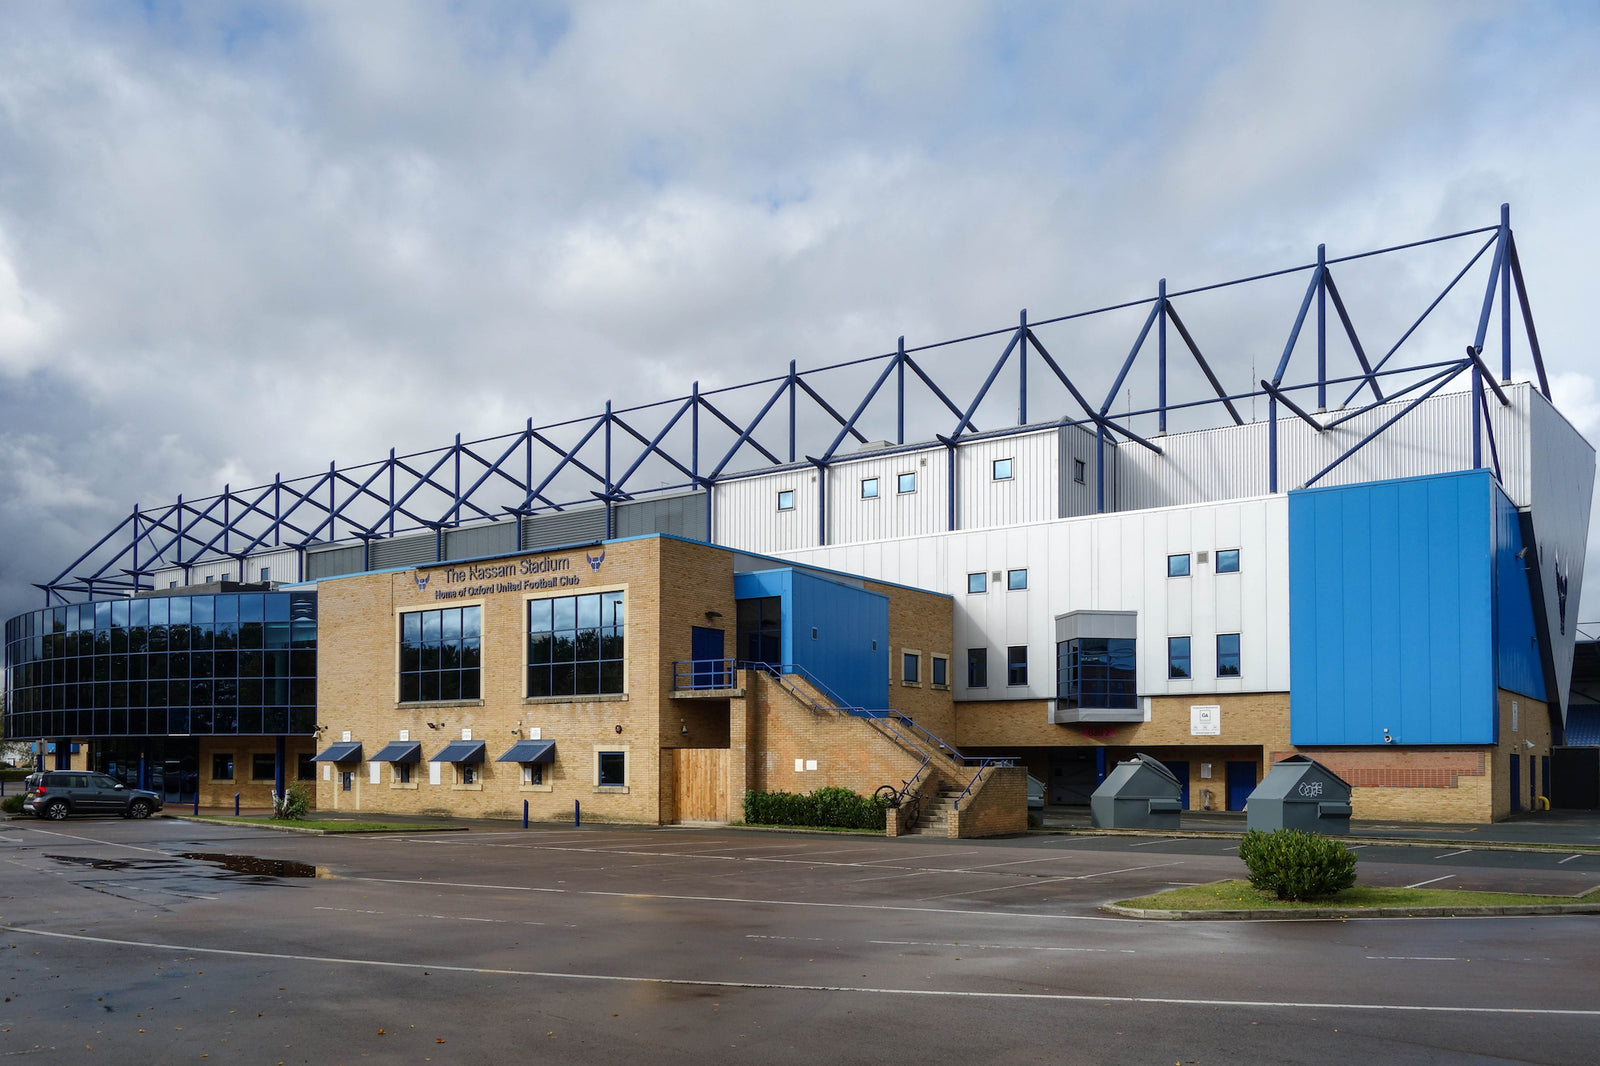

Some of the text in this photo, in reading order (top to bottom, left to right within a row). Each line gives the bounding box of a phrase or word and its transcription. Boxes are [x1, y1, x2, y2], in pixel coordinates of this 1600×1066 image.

[445, 557, 569, 583] The Kassam Stadium
[435, 575, 580, 600] Home of Oxford United Football Club
